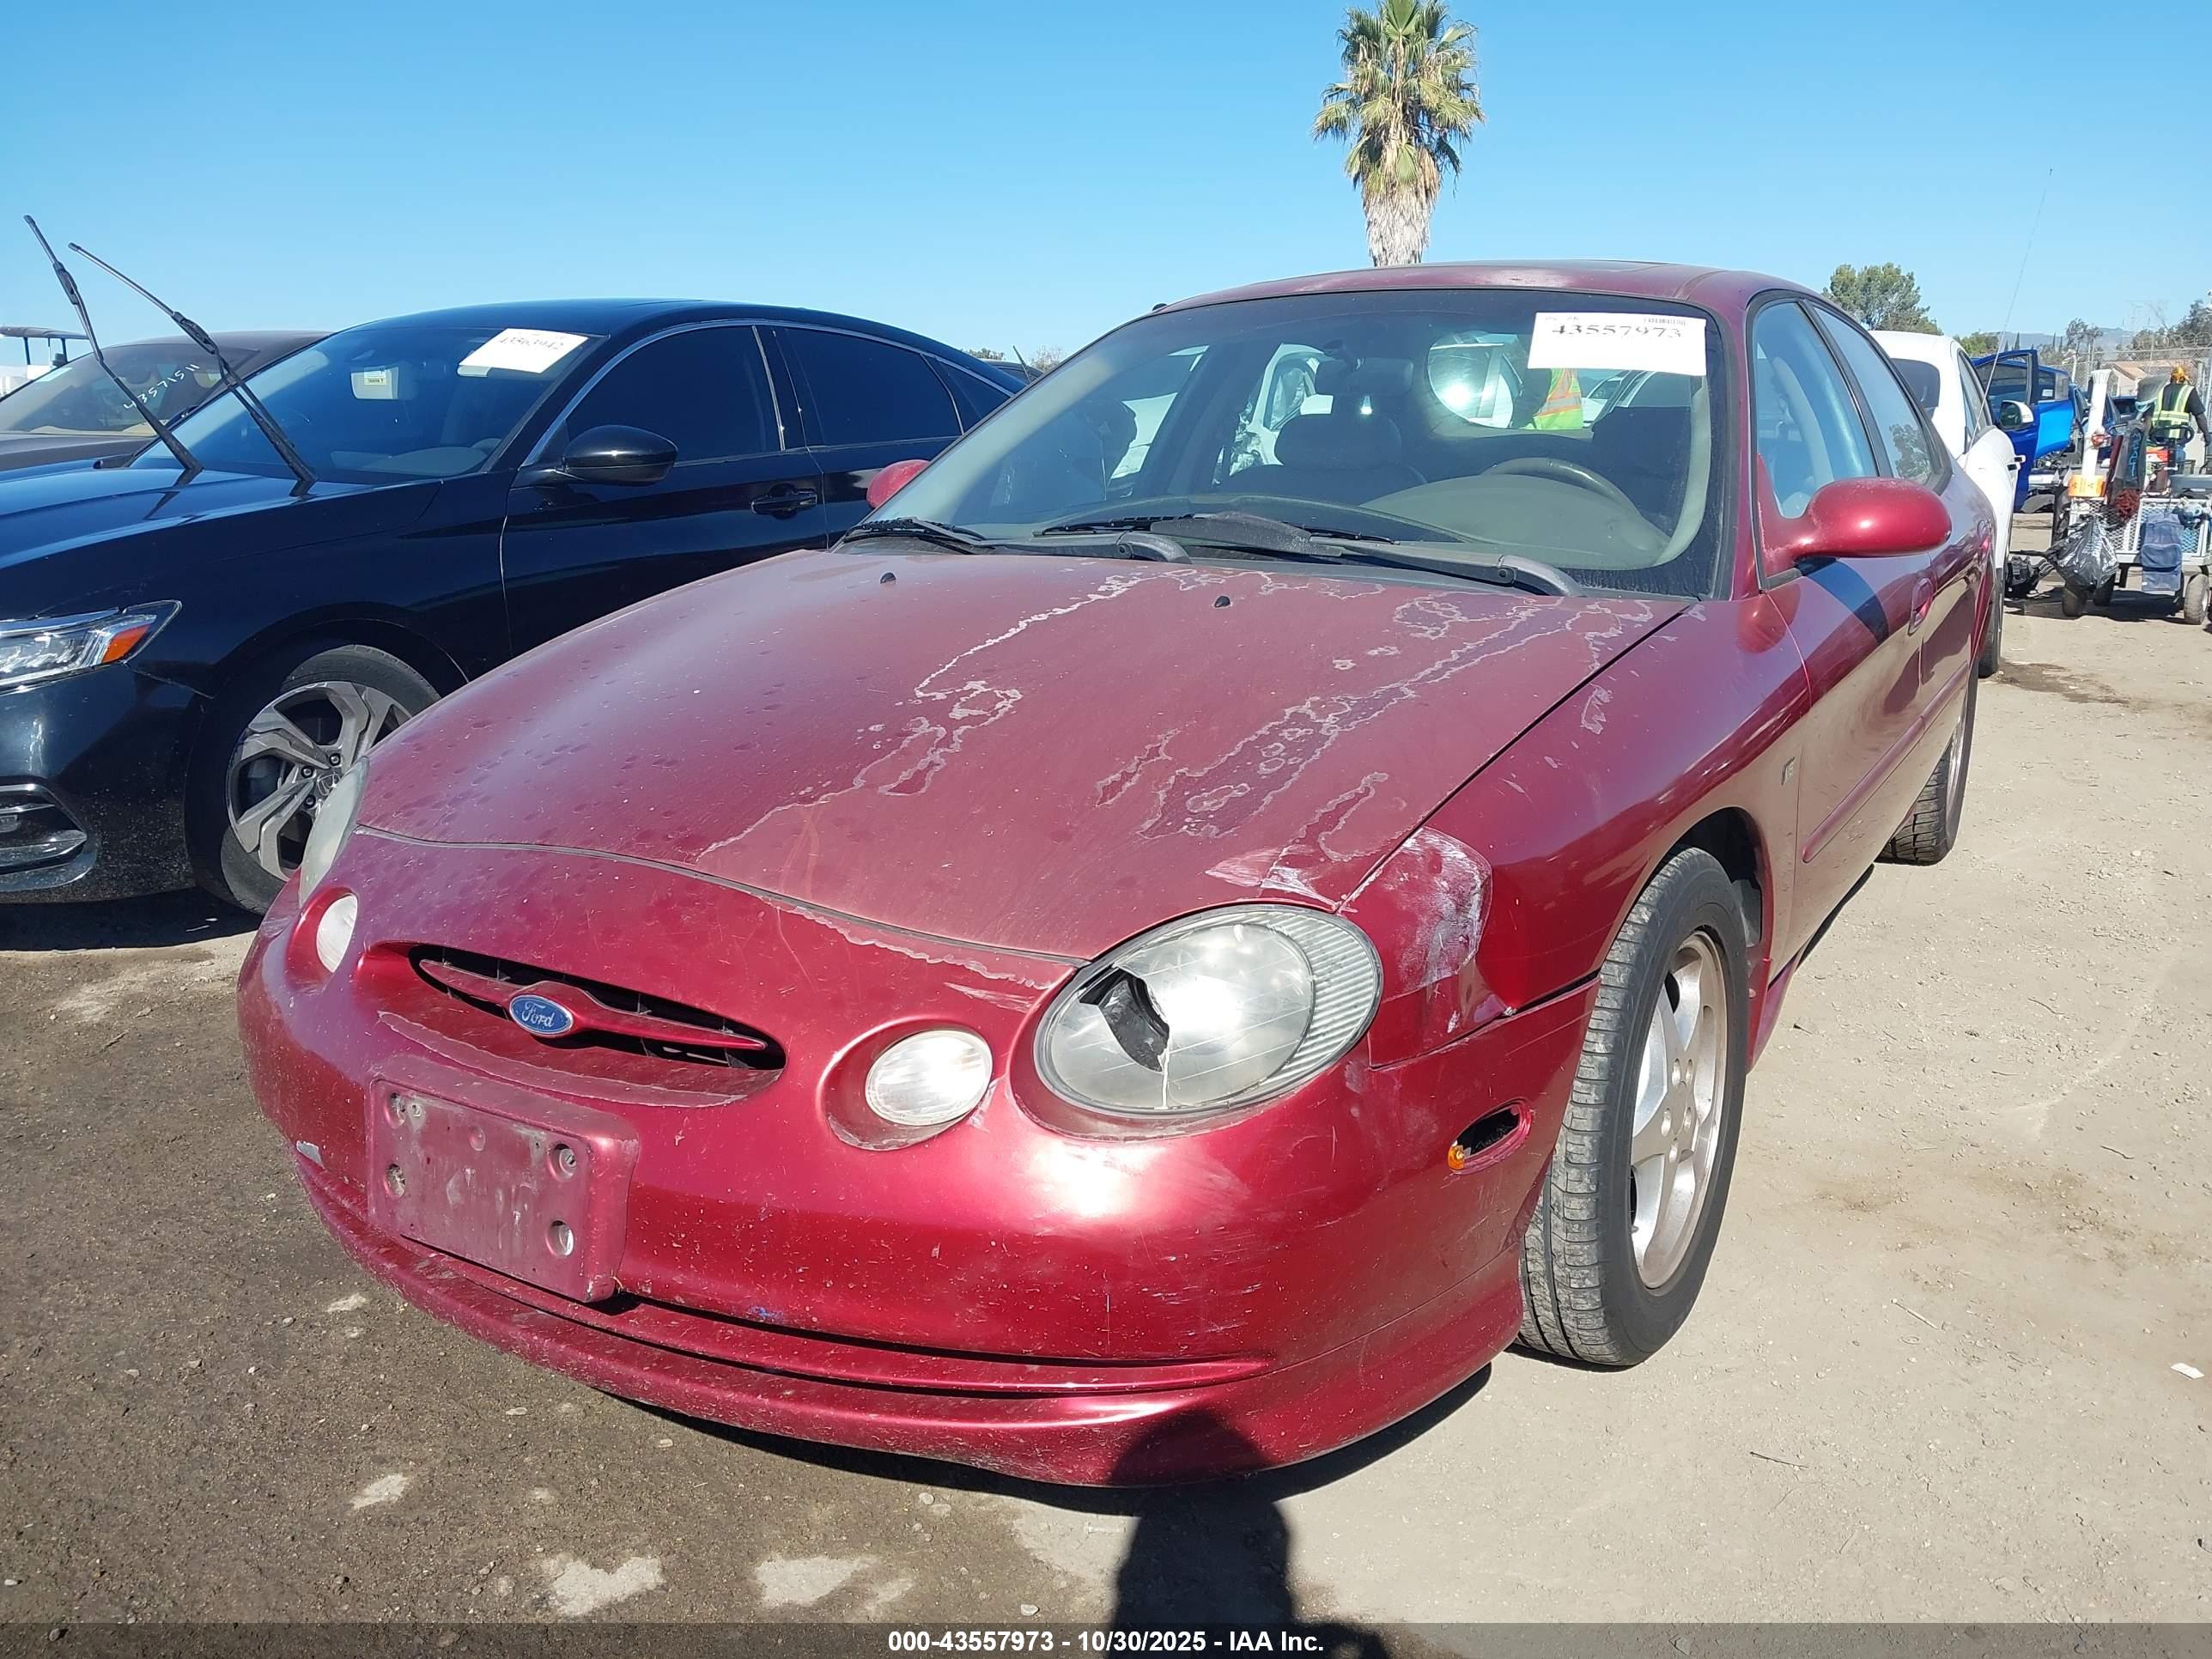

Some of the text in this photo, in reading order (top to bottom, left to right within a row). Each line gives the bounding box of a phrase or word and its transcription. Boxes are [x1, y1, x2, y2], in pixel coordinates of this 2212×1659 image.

[1552, 324, 1683, 339] 43557973
[123, 363, 200, 410] 43571511
[521, 1001, 556, 1028] Ford
